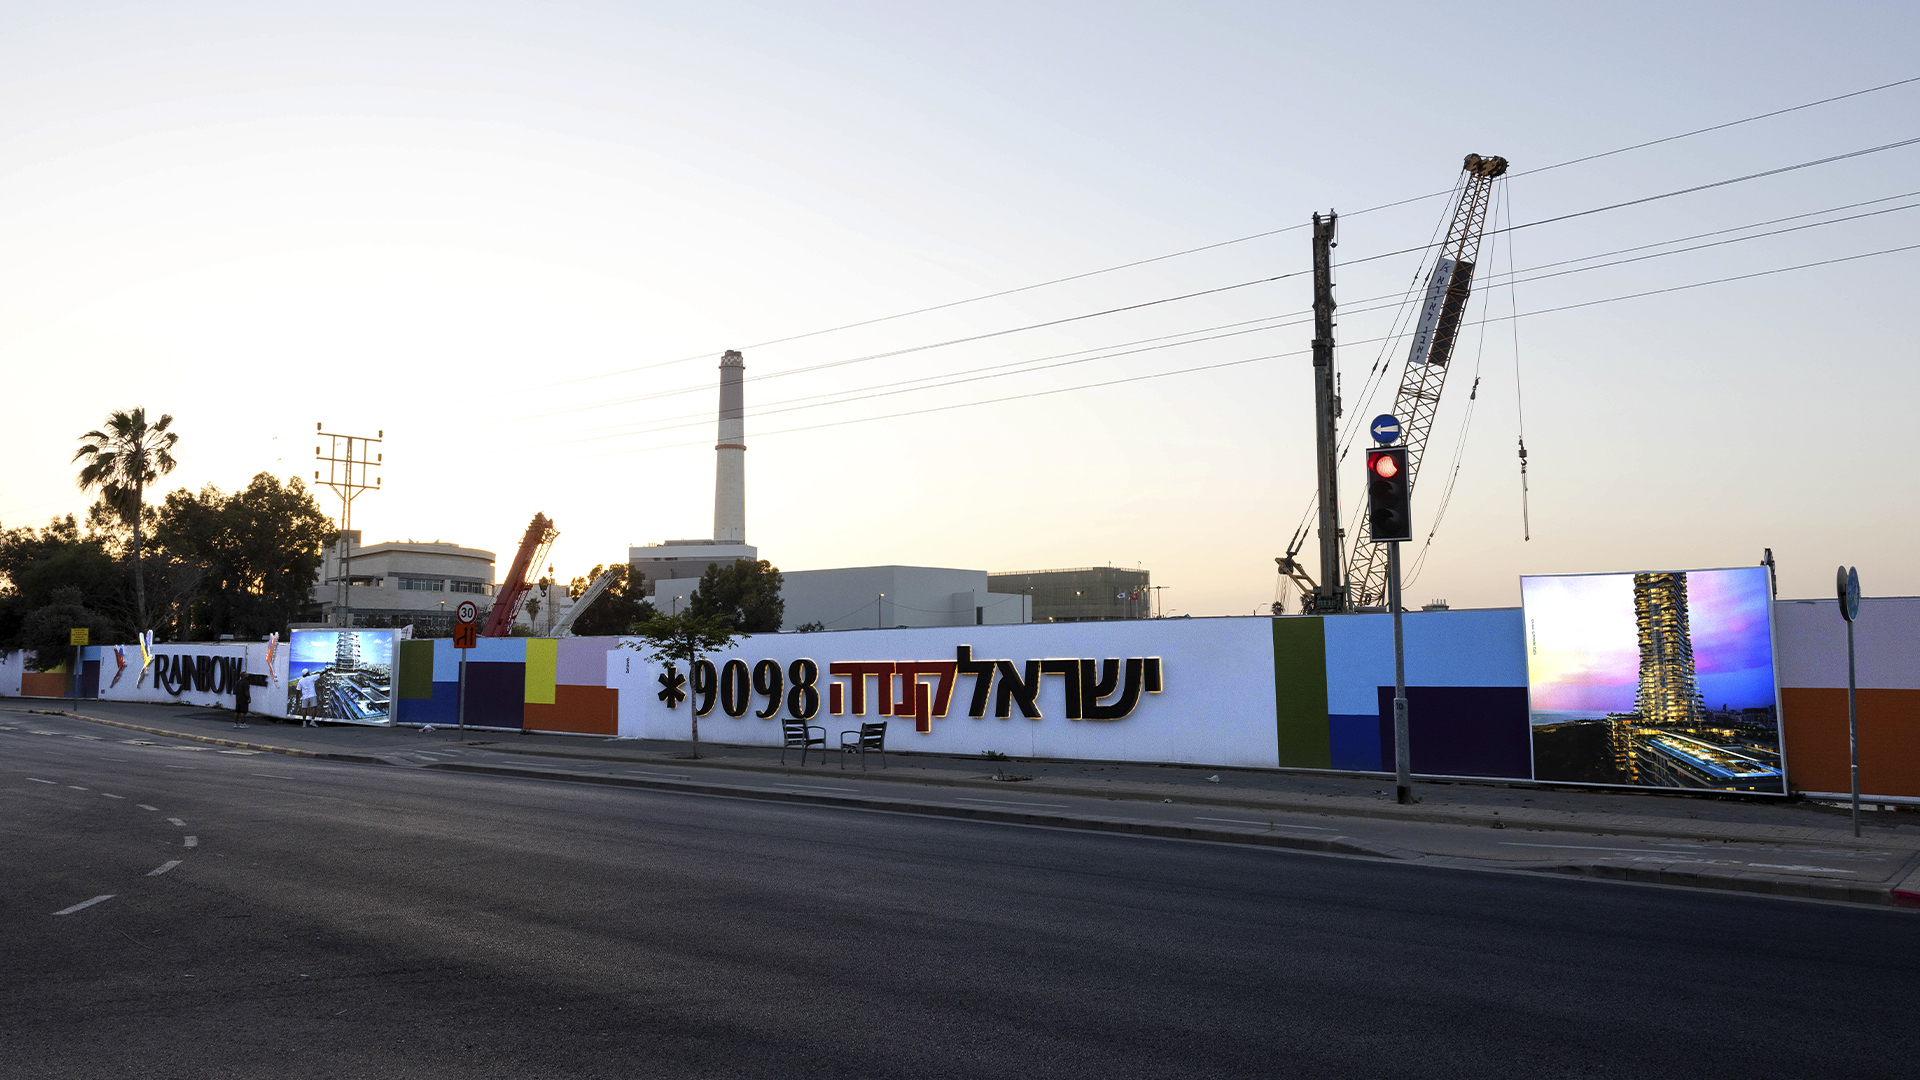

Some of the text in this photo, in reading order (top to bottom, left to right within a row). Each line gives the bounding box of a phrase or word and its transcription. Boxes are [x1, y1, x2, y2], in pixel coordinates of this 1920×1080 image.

[461, 607, 473, 618] 30
[154, 654, 243, 695] RAINBOW
[957, 644, 1162, 721] ישראל
[829, 660, 958, 733] קנדה
[1396, 702, 1404, 710] 10
